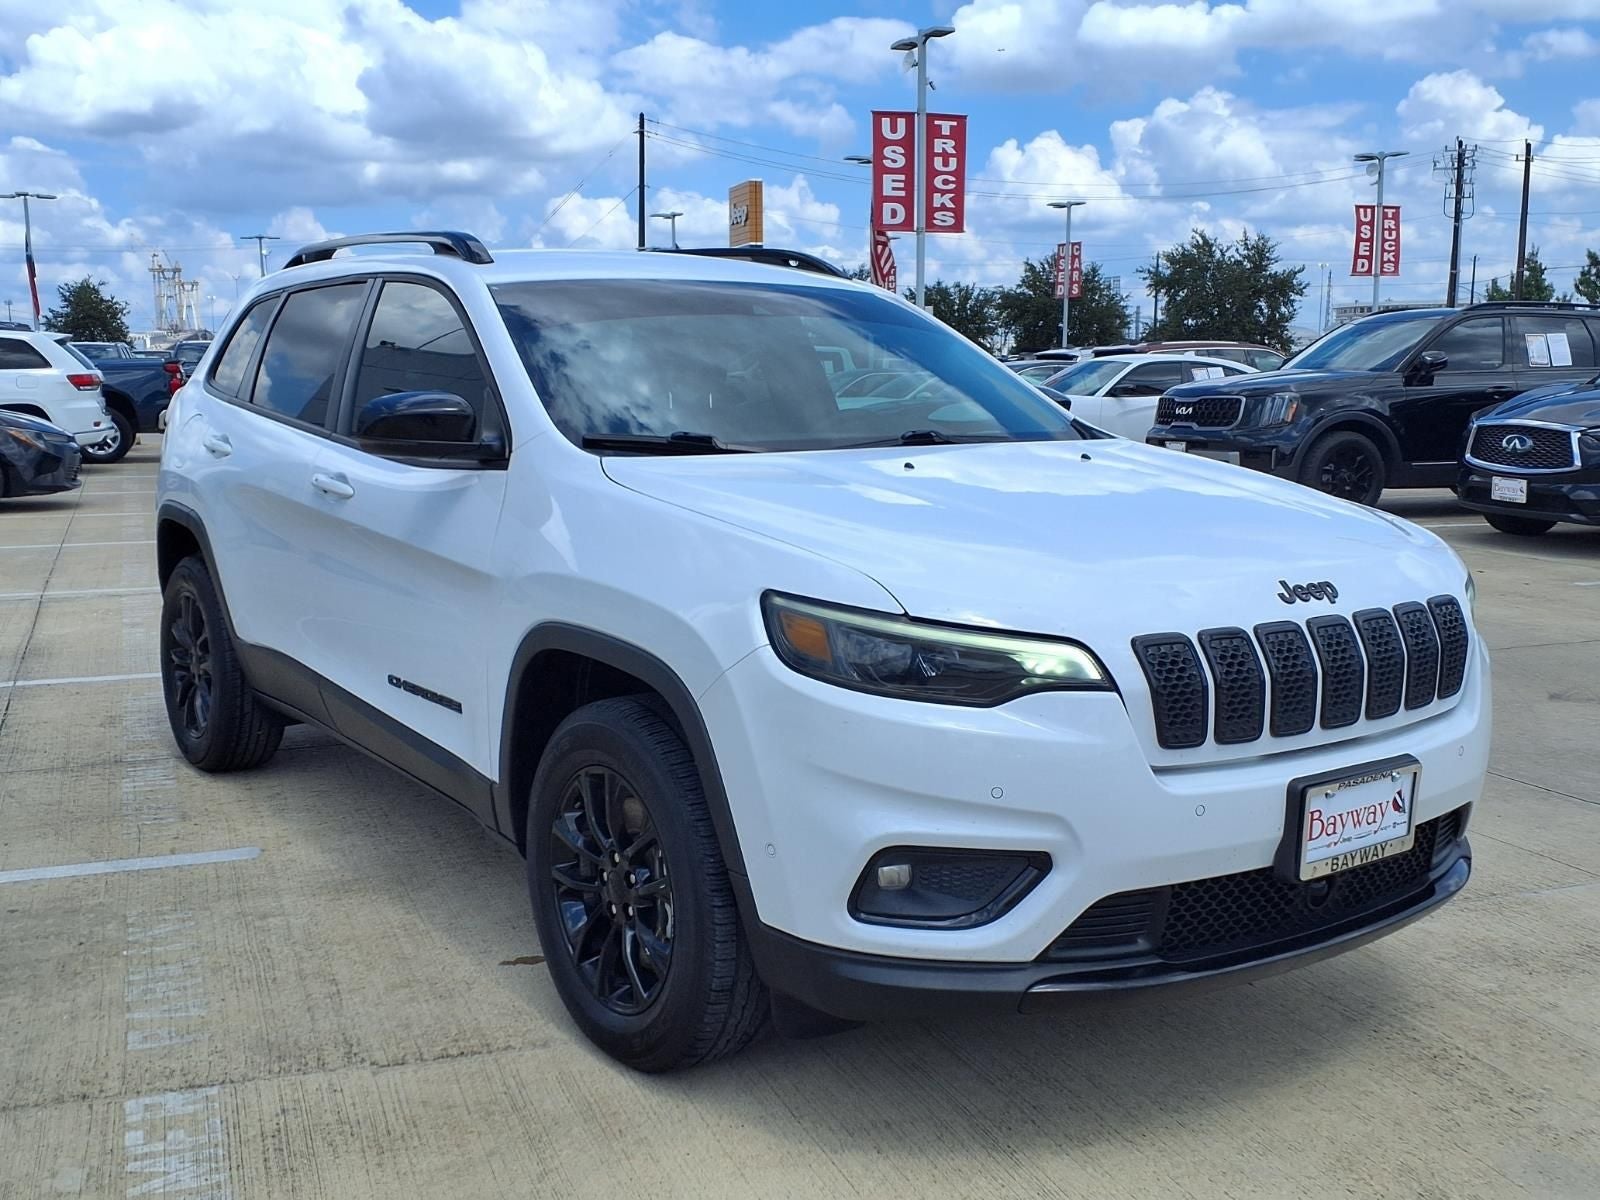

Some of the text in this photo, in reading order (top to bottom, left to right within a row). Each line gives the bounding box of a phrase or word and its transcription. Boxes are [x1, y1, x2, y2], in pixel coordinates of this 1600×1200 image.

[881, 117, 906, 225] USED
[933, 120, 957, 227] TRUCKS
[1356, 208, 1372, 272] USED
[1382, 208, 1397, 272] TRUCKS
[1057, 246, 1066, 295] USED
[1071, 245, 1081, 295] CARS
[1277, 580, 1339, 605] Jeep
[1337, 770, 1393, 790] PASADENA
[1307, 800, 1390, 847] Bayway
[1330, 843, 1388, 872] BAYWAY
